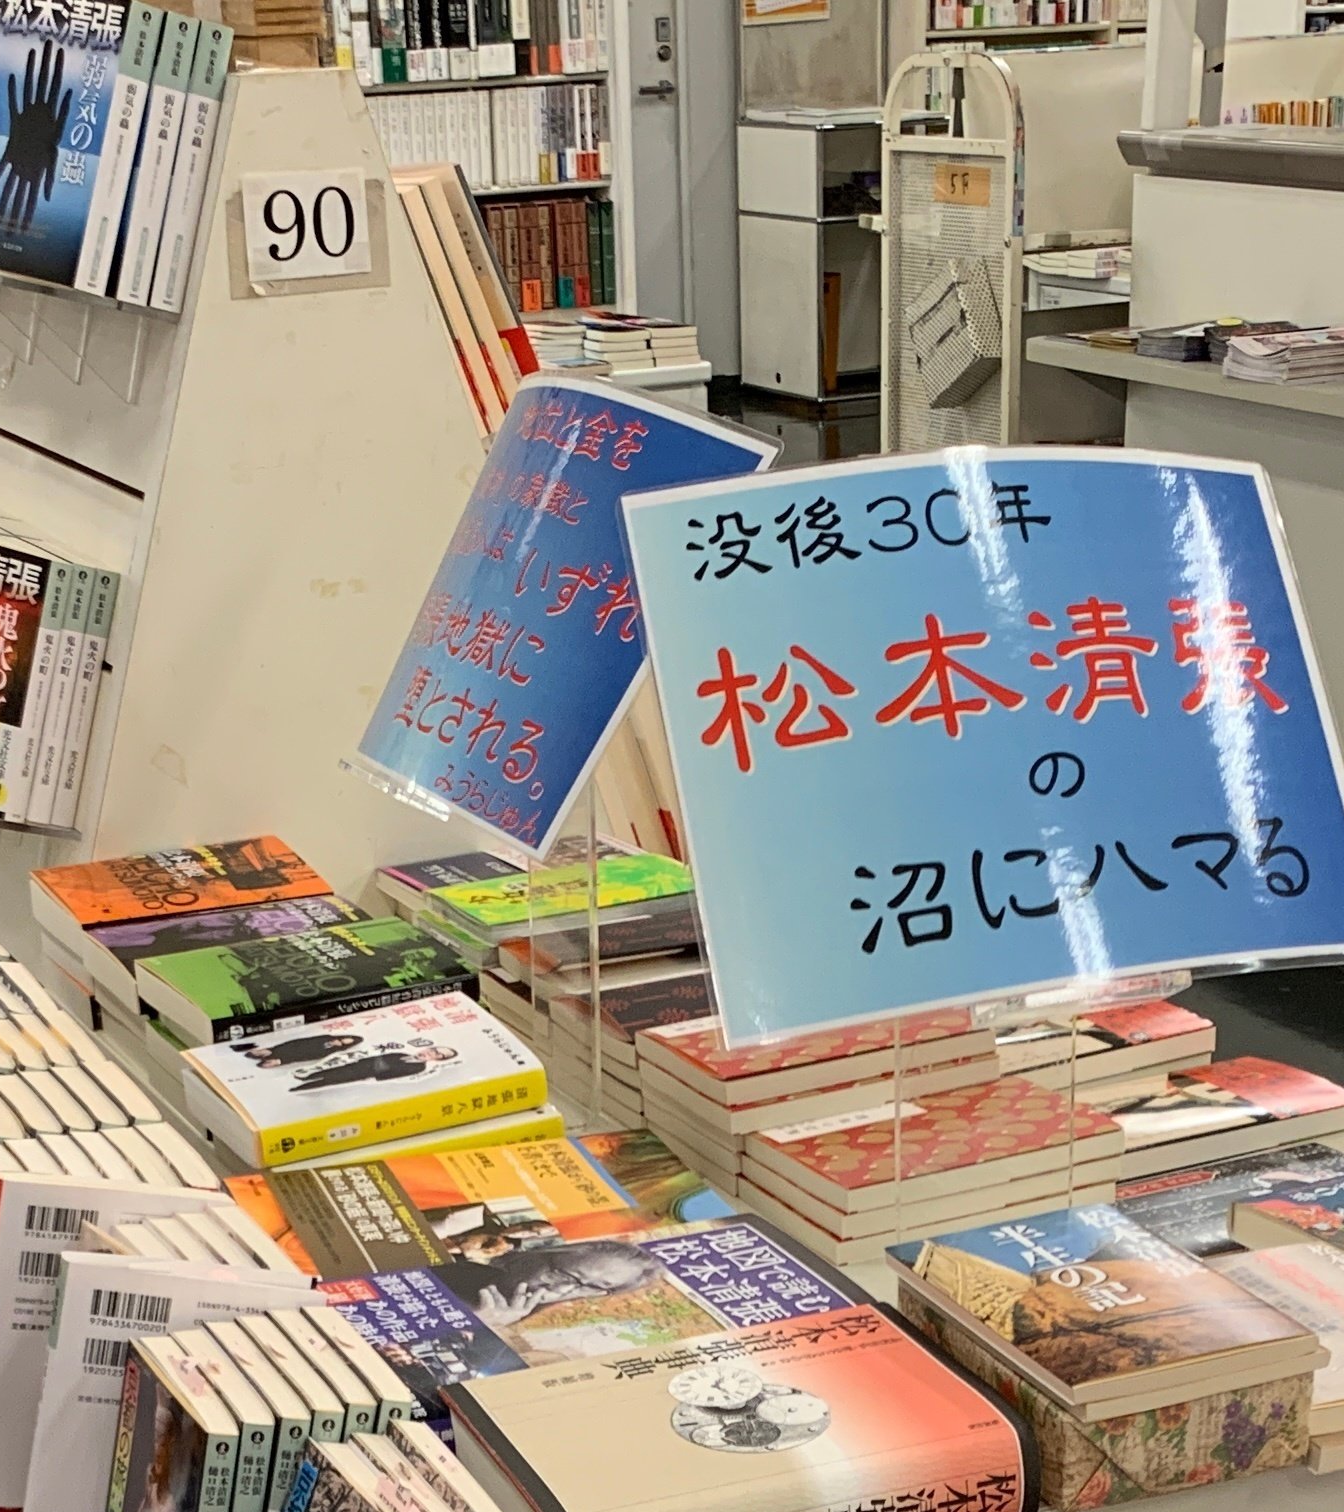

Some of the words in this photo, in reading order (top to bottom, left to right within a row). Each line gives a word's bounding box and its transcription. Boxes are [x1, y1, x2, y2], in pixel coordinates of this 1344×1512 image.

[1, 0, 122, 53] 松本清張
[261, 186, 356, 262] 90
[684, 483, 1053, 583] 没後30年
[514, 547, 641, 643] いずれ
[694, 595, 1293, 778] 松本清張
[392, 664, 546, 801] 堕とされる。
[1028, 750, 1086, 800] の
[434, 763, 544, 847] みうらじゅん
[847, 816, 1312, 956] 沼にハマる
[442, 1086, 529, 1117] 清張地獄八景
[650, 1234, 773, 1327] 松本清張
[701, 1225, 832, 1316] 地図で読む
[988, 1224, 1147, 1313] 半生の記
[600, 1312, 879, 1382] 松本清張事典
